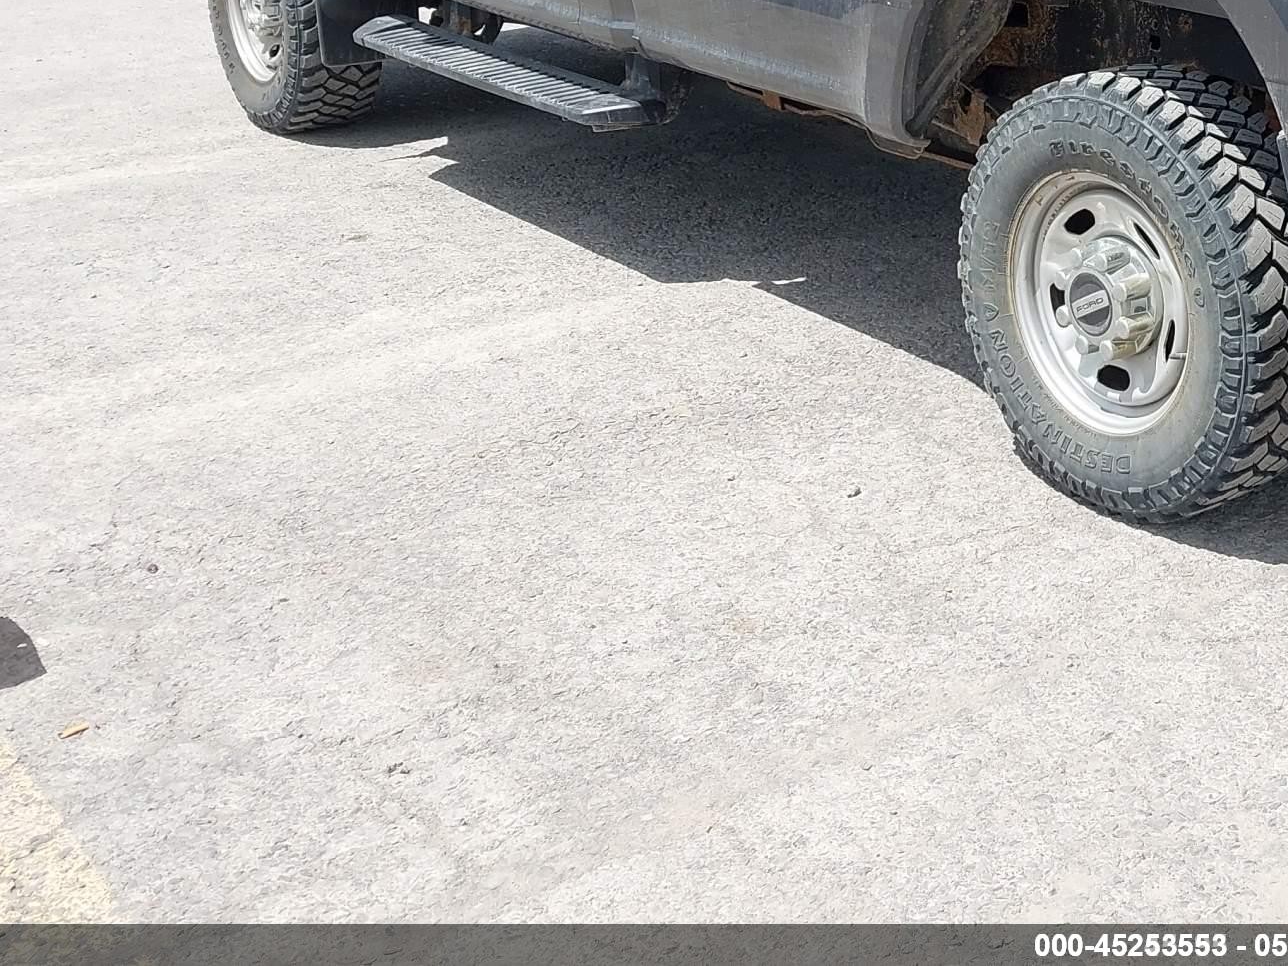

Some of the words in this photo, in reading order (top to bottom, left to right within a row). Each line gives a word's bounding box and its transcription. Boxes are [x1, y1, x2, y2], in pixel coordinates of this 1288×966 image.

[1048, 138, 1197, 279] Firestone
[1076, 297, 1104, 313] FORD
[989, 328, 1132, 475] DESTINATION
